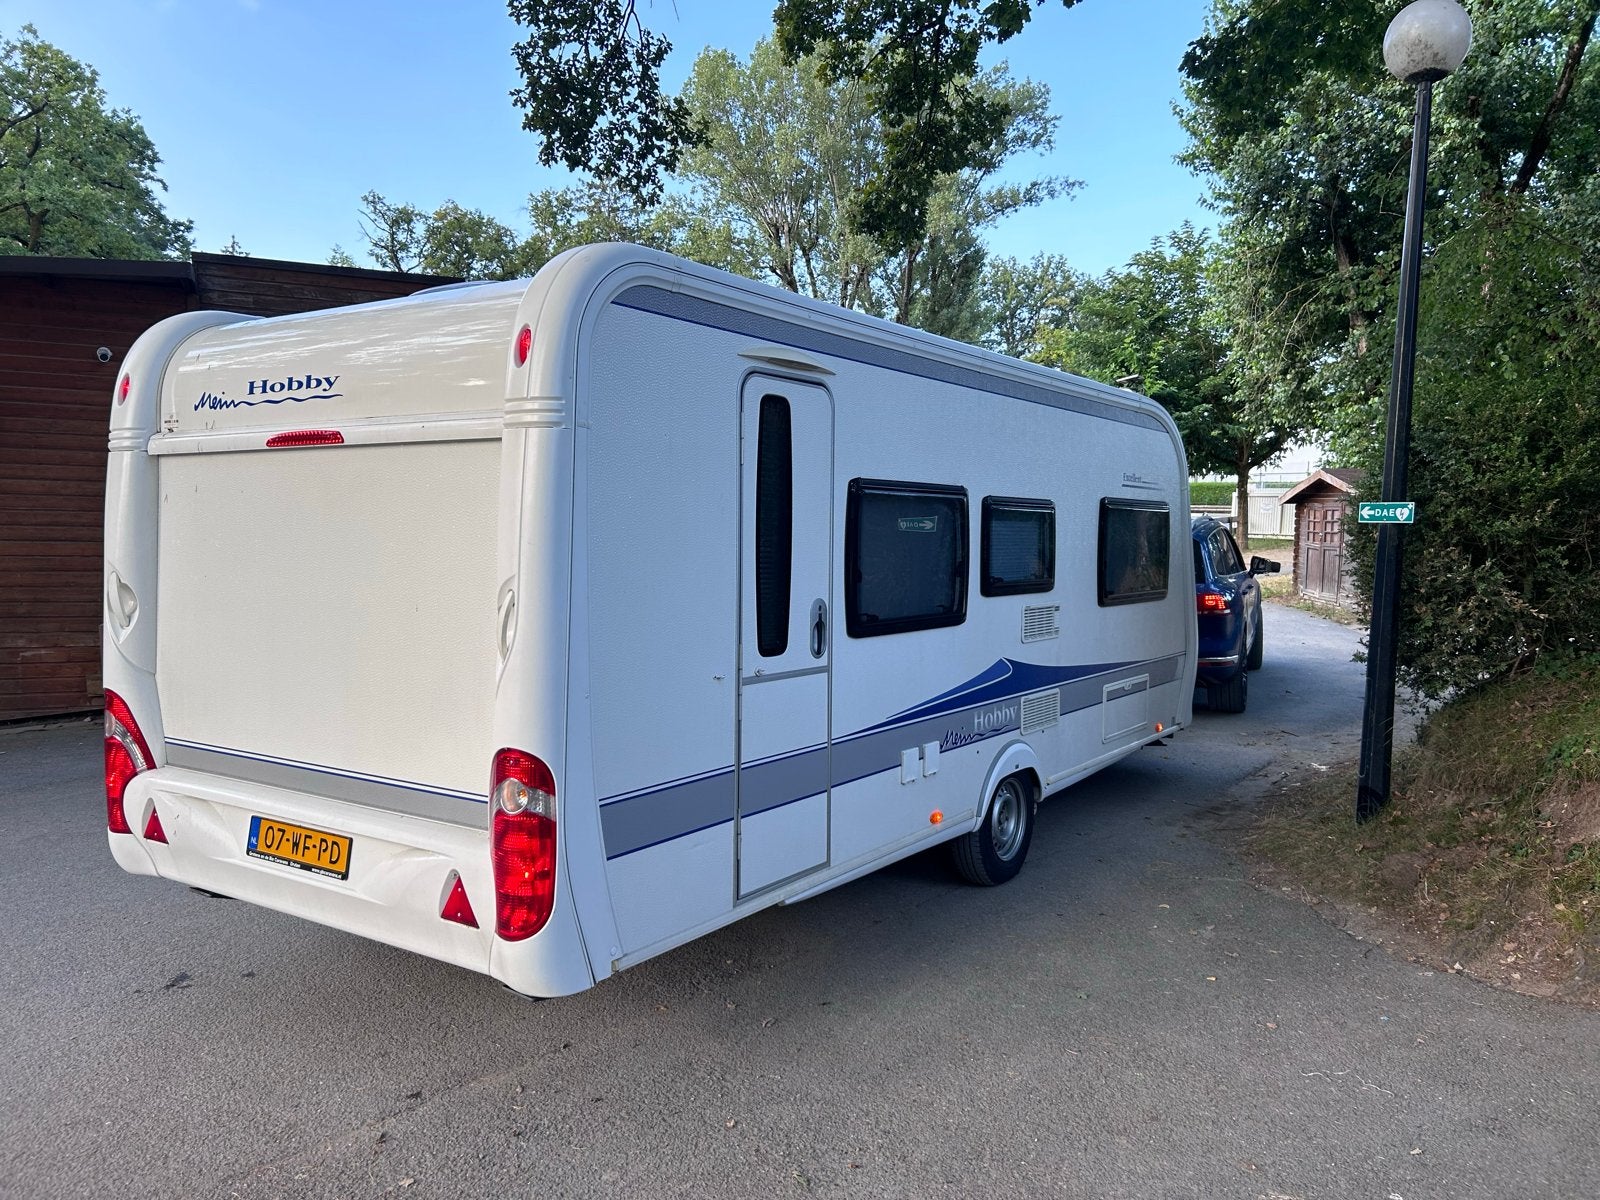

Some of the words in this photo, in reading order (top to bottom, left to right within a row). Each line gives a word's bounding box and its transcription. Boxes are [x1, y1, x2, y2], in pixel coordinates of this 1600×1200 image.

[247, 374, 341, 396] Hobby
[194, 391, 241, 412] Mein
[1374, 508, 1396, 517] DAE
[974, 703, 1018, 732] Hobby
[940, 726, 977, 750] Mein
[250, 836, 257, 845] NL
[264, 825, 341, 865] 07-WF-PD
